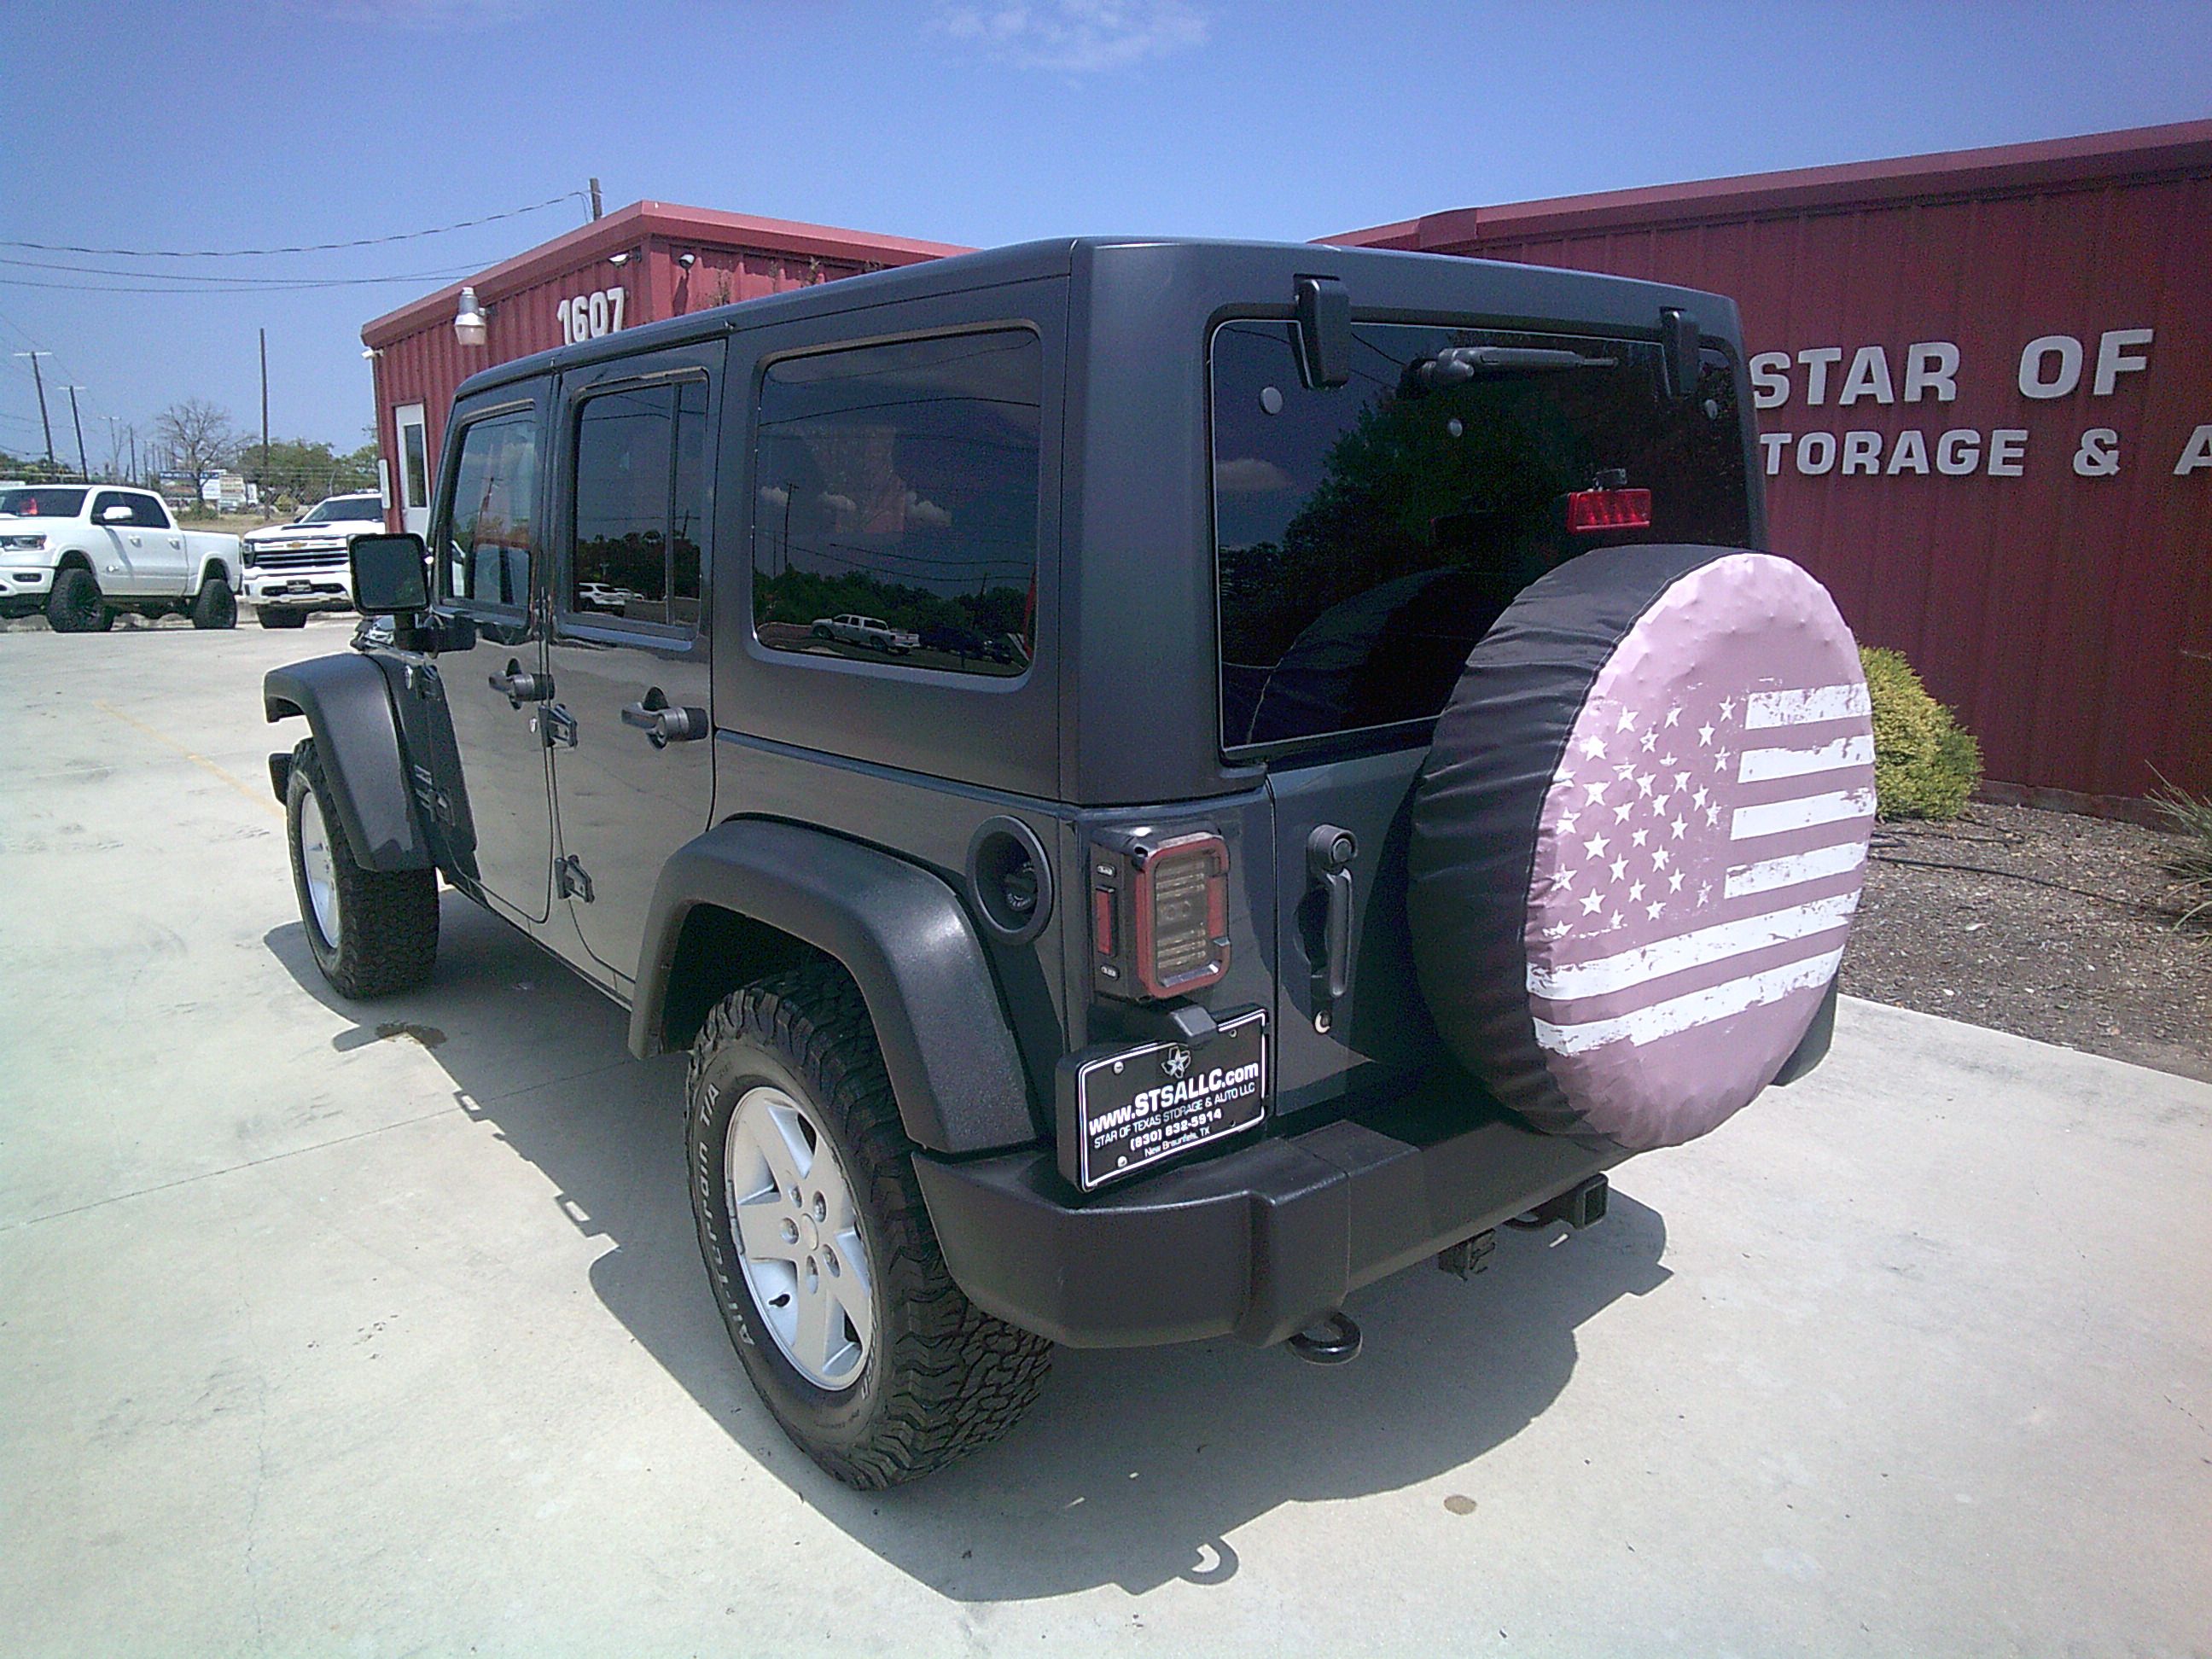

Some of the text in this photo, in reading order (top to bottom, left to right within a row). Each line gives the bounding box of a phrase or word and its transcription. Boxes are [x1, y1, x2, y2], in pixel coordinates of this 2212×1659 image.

[556, 287, 625, 346] 1607
[1749, 329, 2153, 408] STAR OF
[1760, 429, 2028, 476] TORAGE
[2073, 428, 2121, 476] &
[1089, 1062, 1259, 1136] www.STSALLC.com
[1094, 1081, 1256, 1149] STAR OF TEXAS STORAGE & AUTO LLC
[1199, 1126, 1211, 1138] TX
